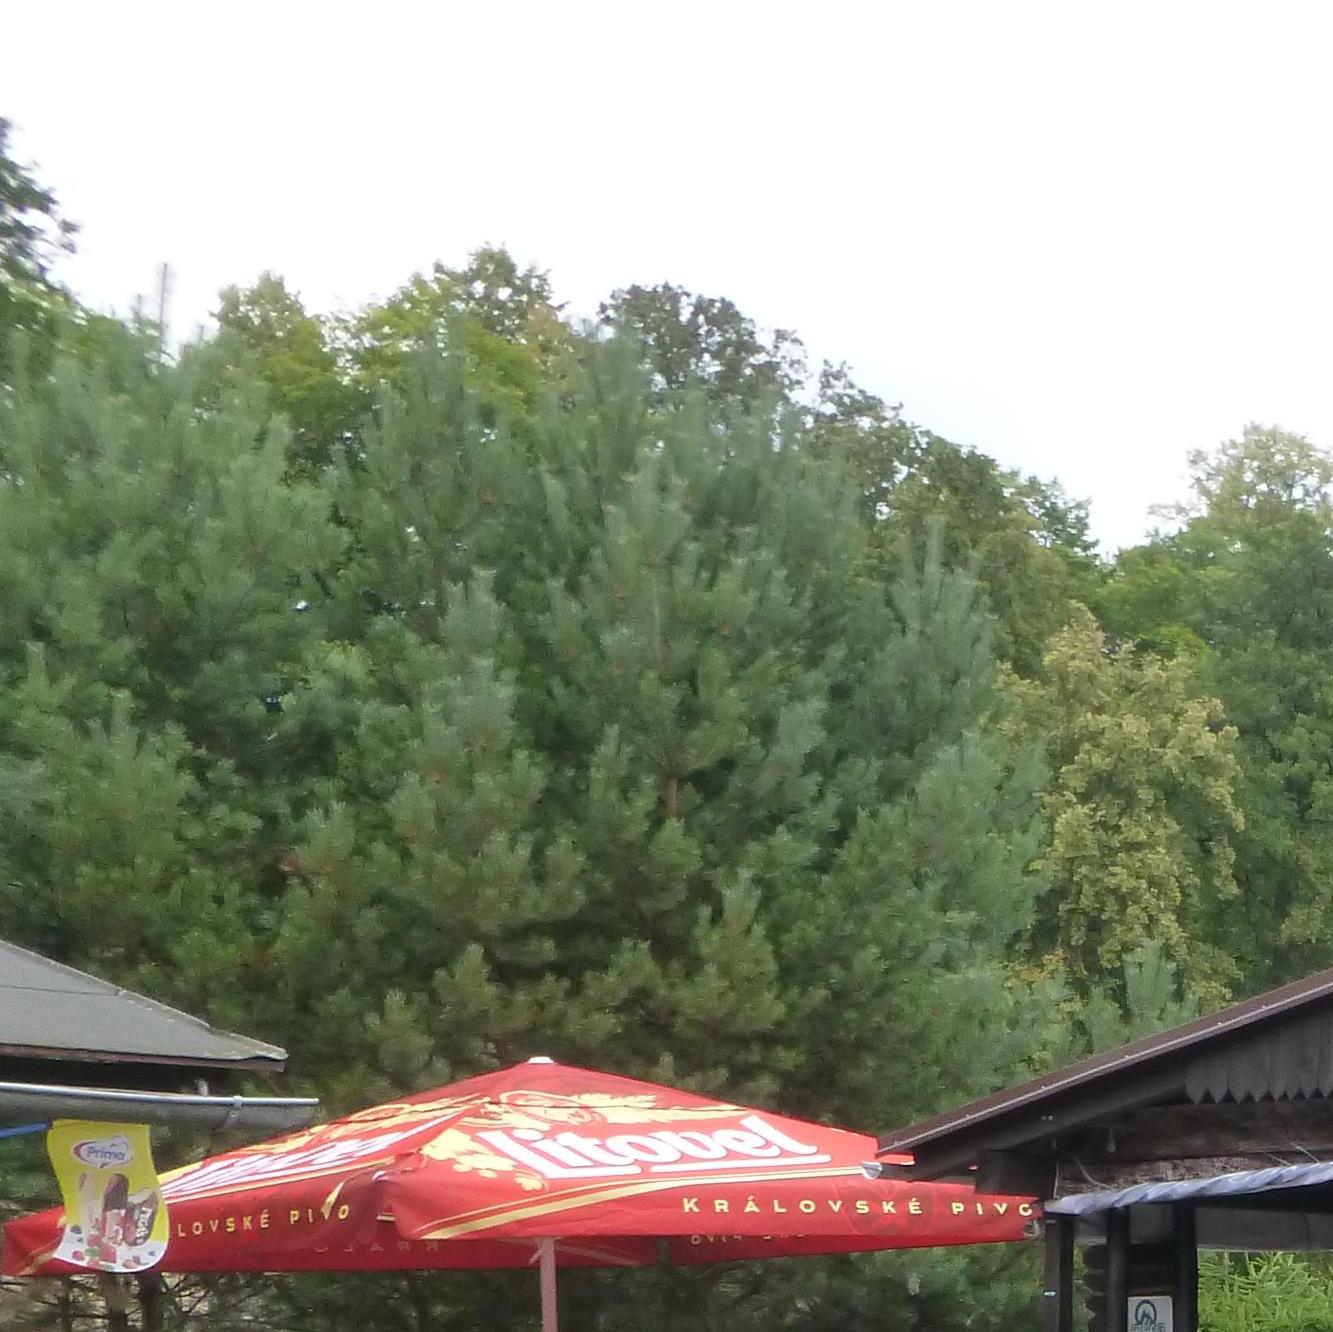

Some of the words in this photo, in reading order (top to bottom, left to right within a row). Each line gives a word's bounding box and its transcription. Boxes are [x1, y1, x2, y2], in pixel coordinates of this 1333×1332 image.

[476, 1114, 820, 1179] Litovel
[683, 1196, 922, 1214] KRÁLOVSKÉ
[177, 1209, 270, 1237] LOVSKÉ
